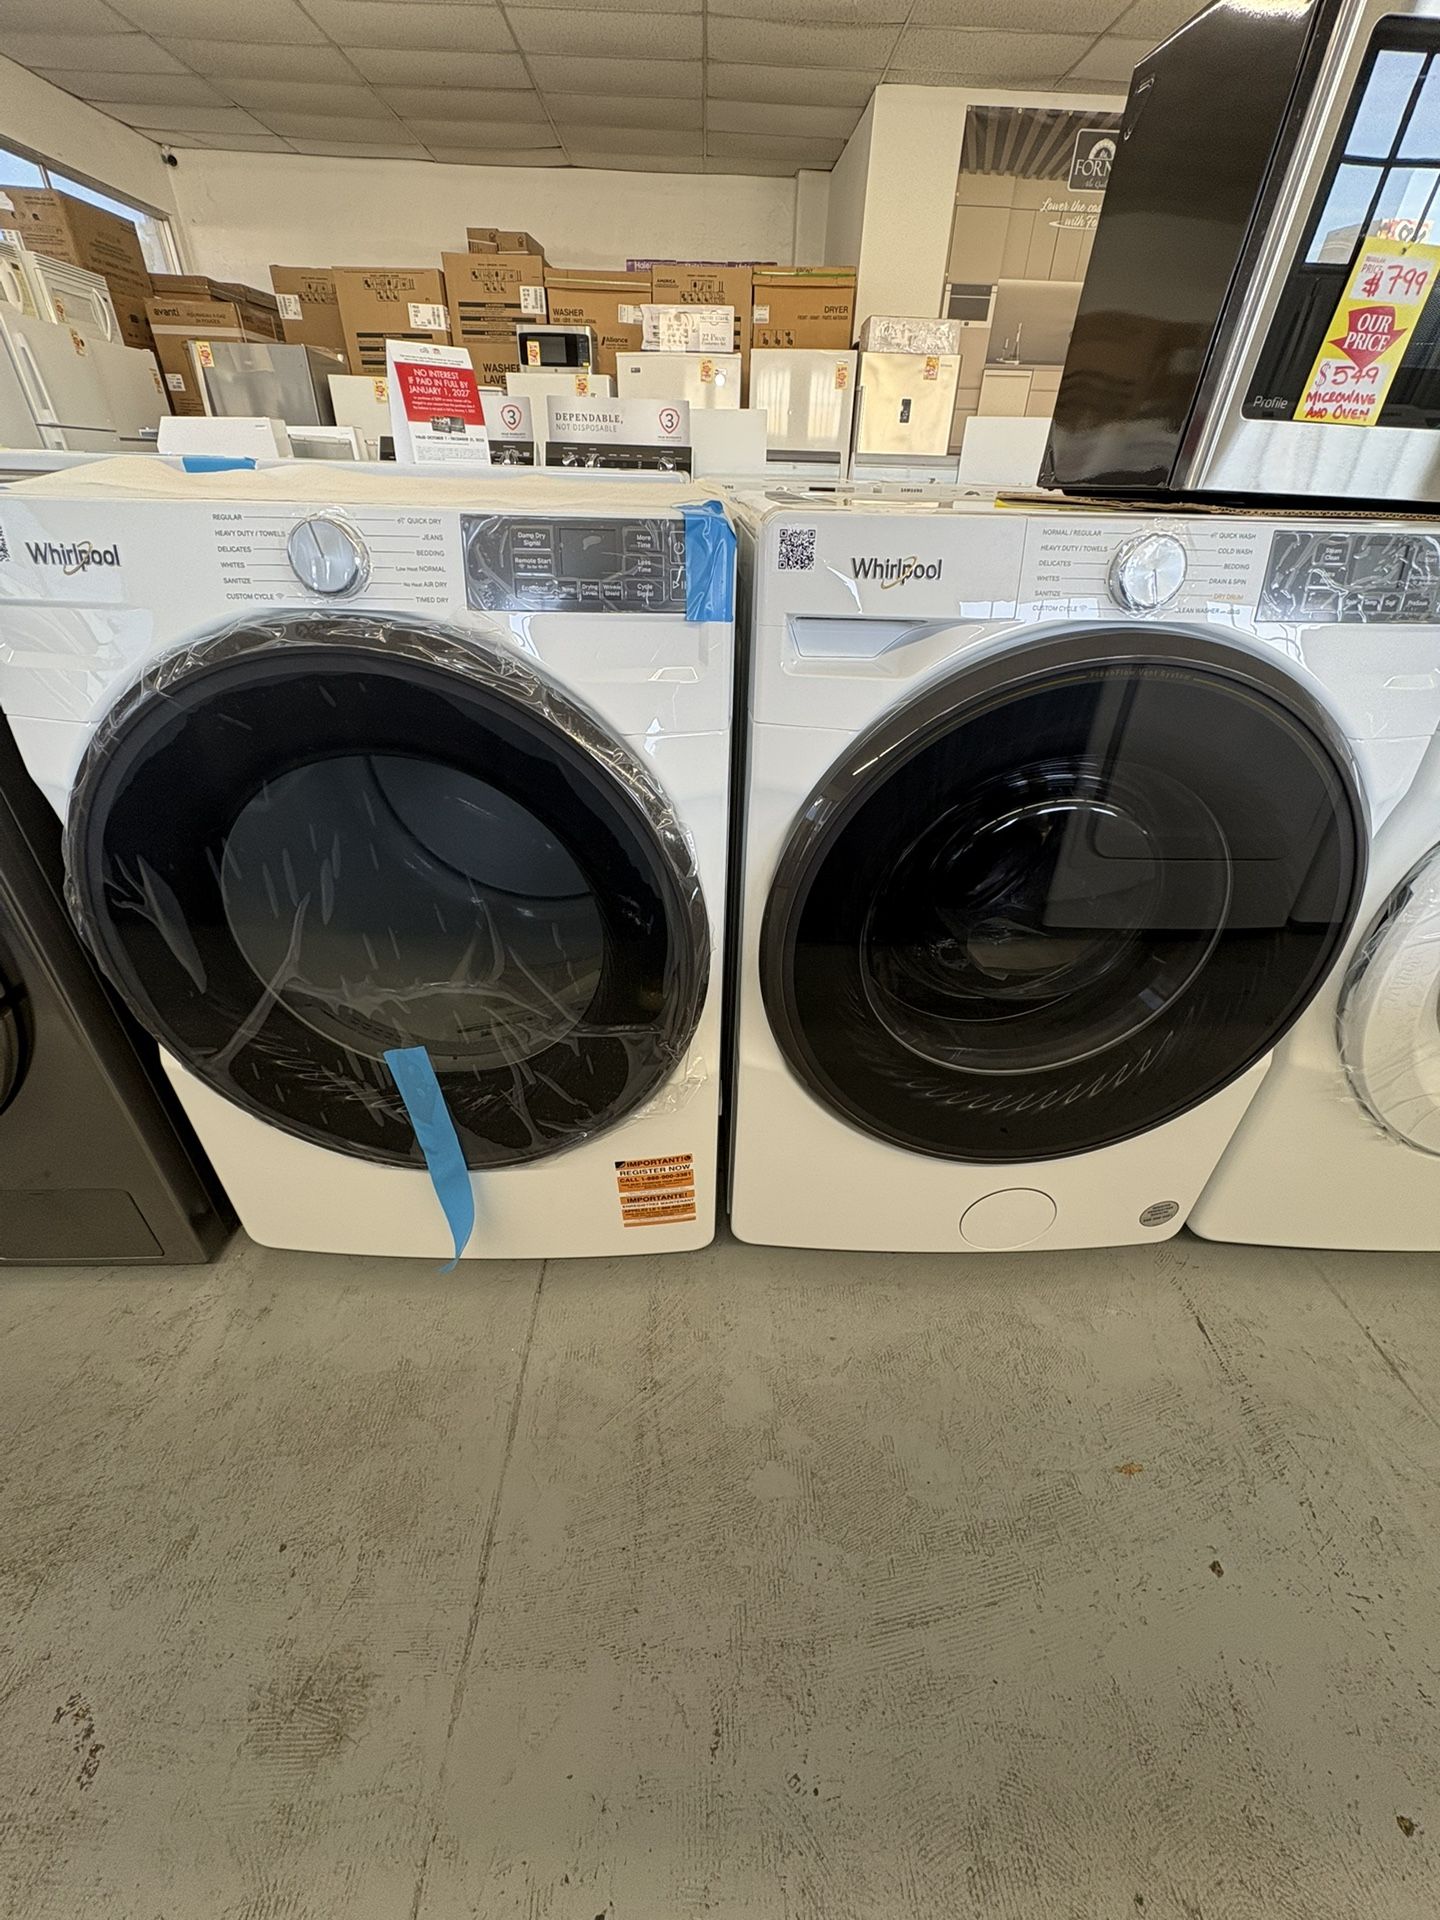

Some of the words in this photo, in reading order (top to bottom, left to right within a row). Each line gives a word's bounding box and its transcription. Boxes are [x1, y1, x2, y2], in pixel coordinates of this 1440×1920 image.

[1039, 197, 1069, 212] Lower
[1071, 200, 1086, 212] the
[1064, 215, 1085, 227] with
[1361, 264, 1384, 275] PRICE
[153, 307, 180, 317] avanti
[552, 308, 584, 316] WASHER
[824, 305, 849, 314] DRYER
[1357, 313, 1393, 333] OUR
[606, 336, 628, 344] Alliance
[1342, 331, 1391, 353] PRICE
[413, 368, 427, 378] NO
[429, 370, 459, 380] INTEREST
[483, 363, 520, 373] WASHER
[407, 376, 414, 384] IF
[416, 376, 433, 386] PAID
[434, 378, 443, 387] IN
[444, 379, 459, 388] FULL
[460, 380, 469, 389] BY
[409, 385, 442, 395] JANUARY
[453, 389, 471, 398] 2027
[1253, 395, 1289, 409] Profile
[507, 409, 517, 426] 3
[555, 411, 624, 424] DEPENDABLE,
[1332, 404, 1371, 421] OVEN
[665, 413, 675, 429] 3
[555, 423, 570, 432] NOT
[572, 423, 617, 433] DISPOSABLE
[535, 532, 546, 540] Dry
[1042, 528, 1068, 536] NORMAL
[523, 539, 541, 547] Signal
[1082, 545, 1108, 553] TOWELS
[25, 541, 121, 574] Whirlpool
[416, 549, 445, 557] BEDDING
[1038, 559, 1072, 567] DELICATES
[850, 557, 943, 588] Whirlpool
[636, 590, 654, 598] Signal
[626, 1155, 684, 1168] IMPORTANT!
[619, 1167, 666, 1176] REGISTER
[668, 1163, 691, 1172] NOW
[627, 1192, 688, 1204] IMPORTANTE!
